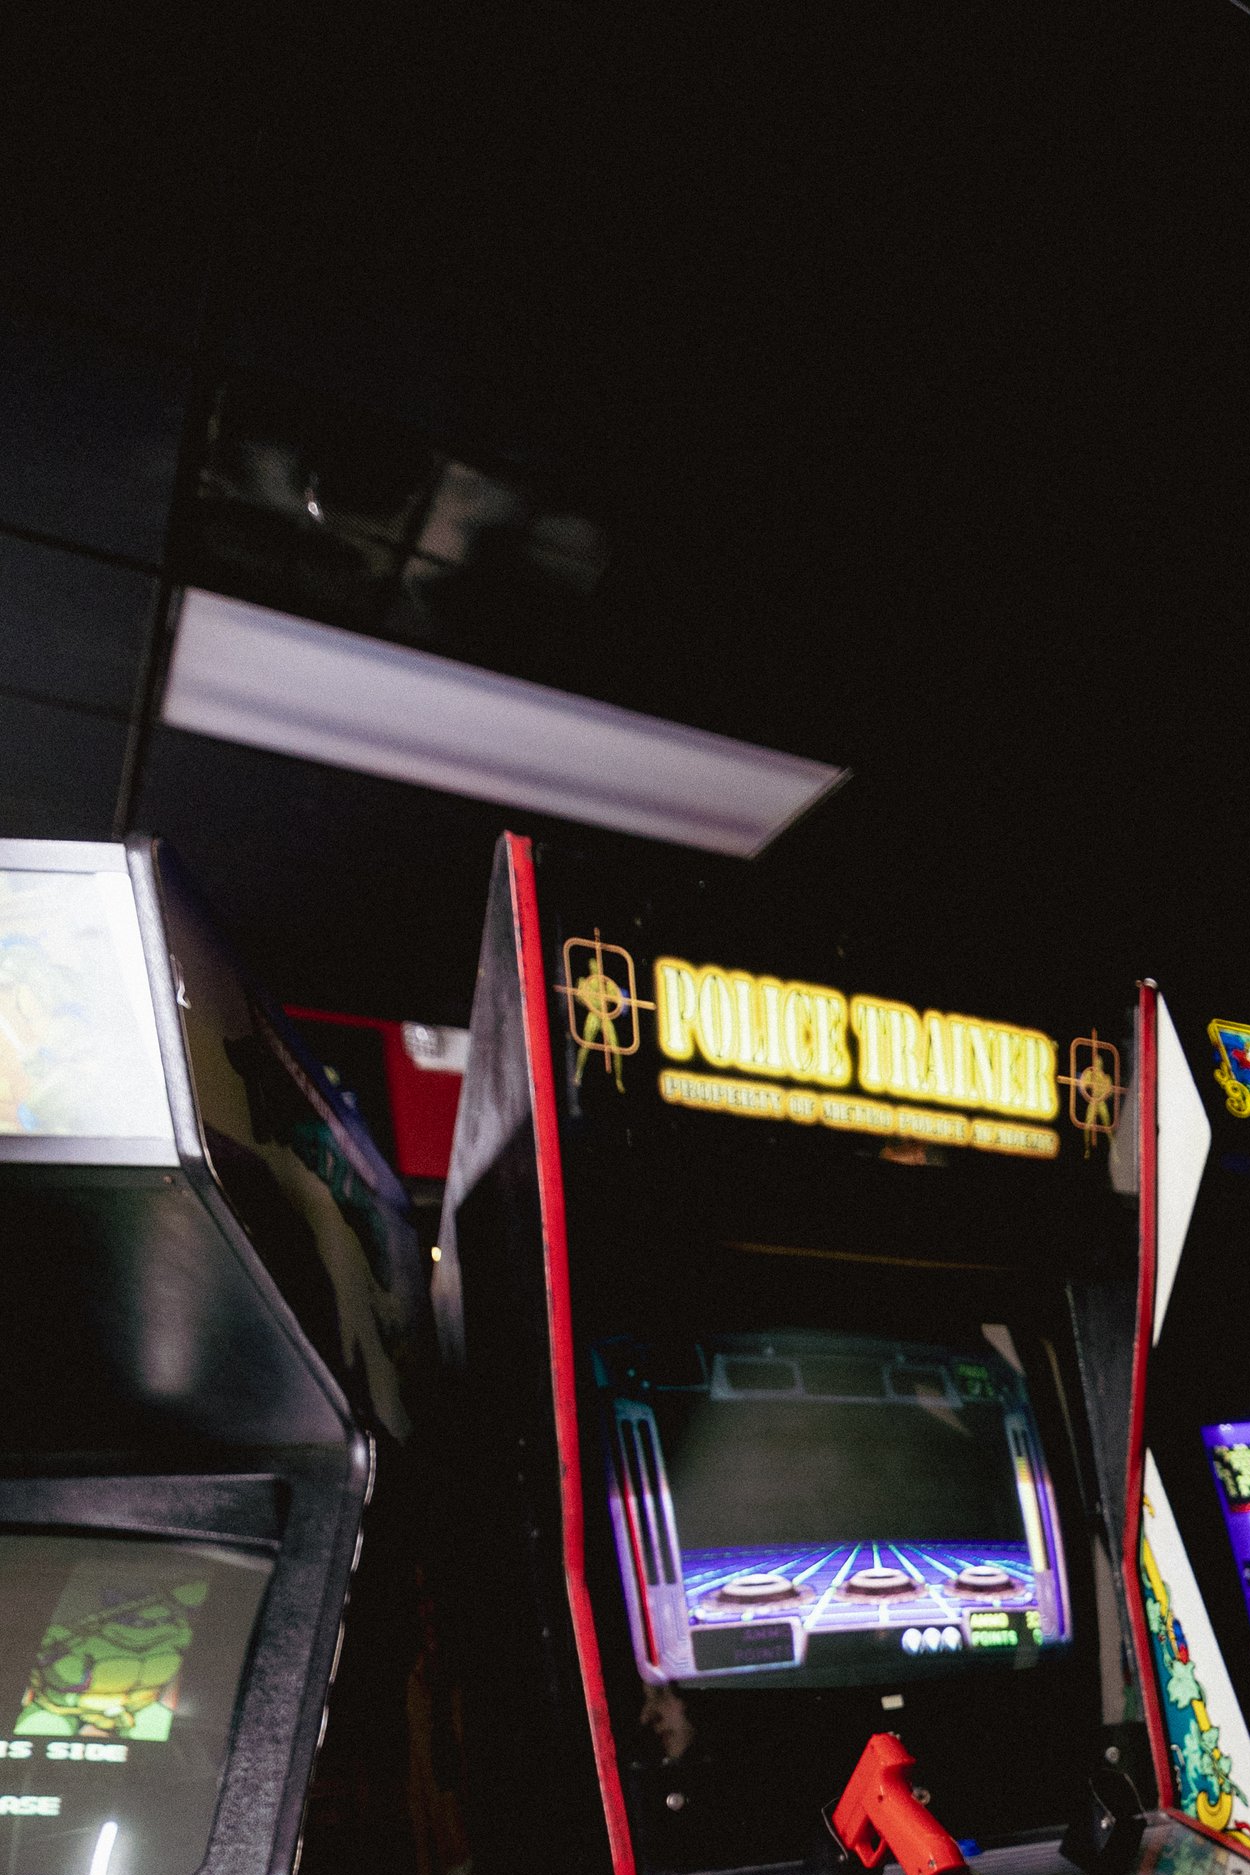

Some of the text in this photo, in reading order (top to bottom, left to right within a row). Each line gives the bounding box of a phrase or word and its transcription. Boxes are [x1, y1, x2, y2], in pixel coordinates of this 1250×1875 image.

[658, 960, 1057, 1116] POLICE TRAINER
[46, 1741, 129, 1763] SIDE
